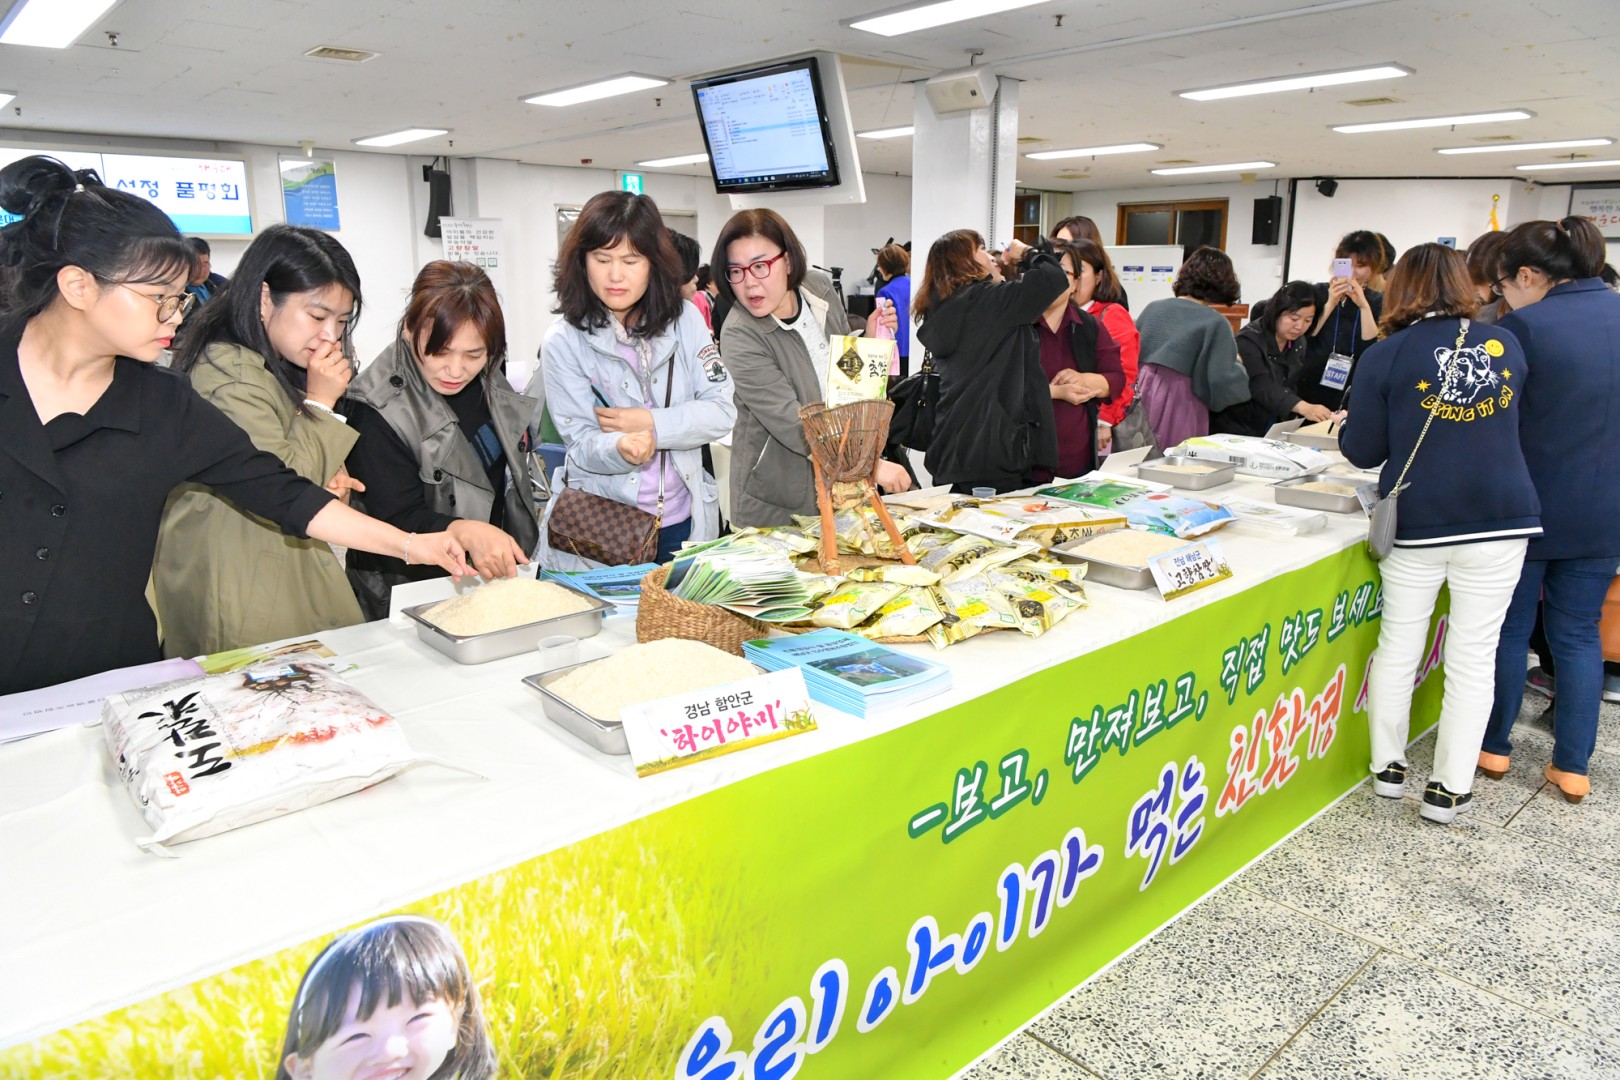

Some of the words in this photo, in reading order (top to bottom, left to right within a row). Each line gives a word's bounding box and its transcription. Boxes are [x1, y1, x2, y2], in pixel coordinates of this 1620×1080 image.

[175, 181, 239, 201] 품평회
[1325, 370, 1346, 381] STAFF
[1499, 385, 1513, 408] ON
[1173, 555, 1186, 567] 전남
[1185, 550, 1202, 563] 해남군
[1221, 626, 1269, 700] 직접
[1279, 609, 1322, 670] 맛도
[684, 700, 711, 720] 경남
[714, 690, 754, 712] 함안군
[660, 699, 781, 752] '하이야미'
[1128, 760, 1206, 886] 먹는
[1217, 667, 1345, 810] 친환경
